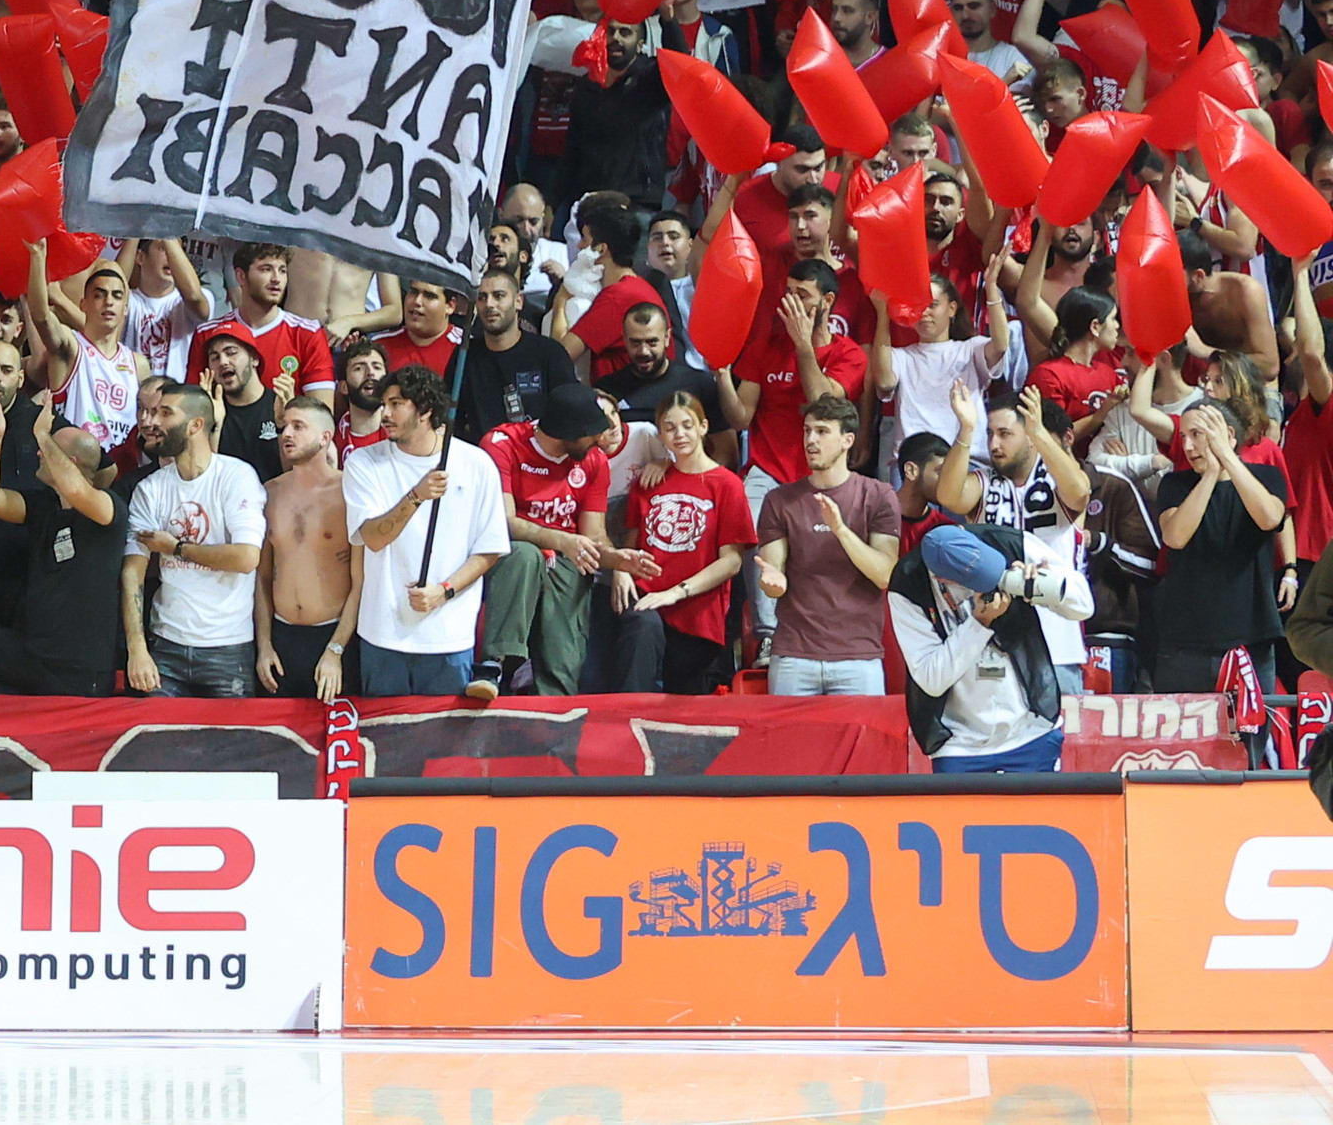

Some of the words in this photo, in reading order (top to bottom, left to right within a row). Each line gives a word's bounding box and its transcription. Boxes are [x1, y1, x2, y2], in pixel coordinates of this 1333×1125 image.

[95, 380, 129, 411] 69
[520, 461, 549, 476] macron
[370, 823, 623, 980] SIG
[795, 821, 1099, 982] סיג
